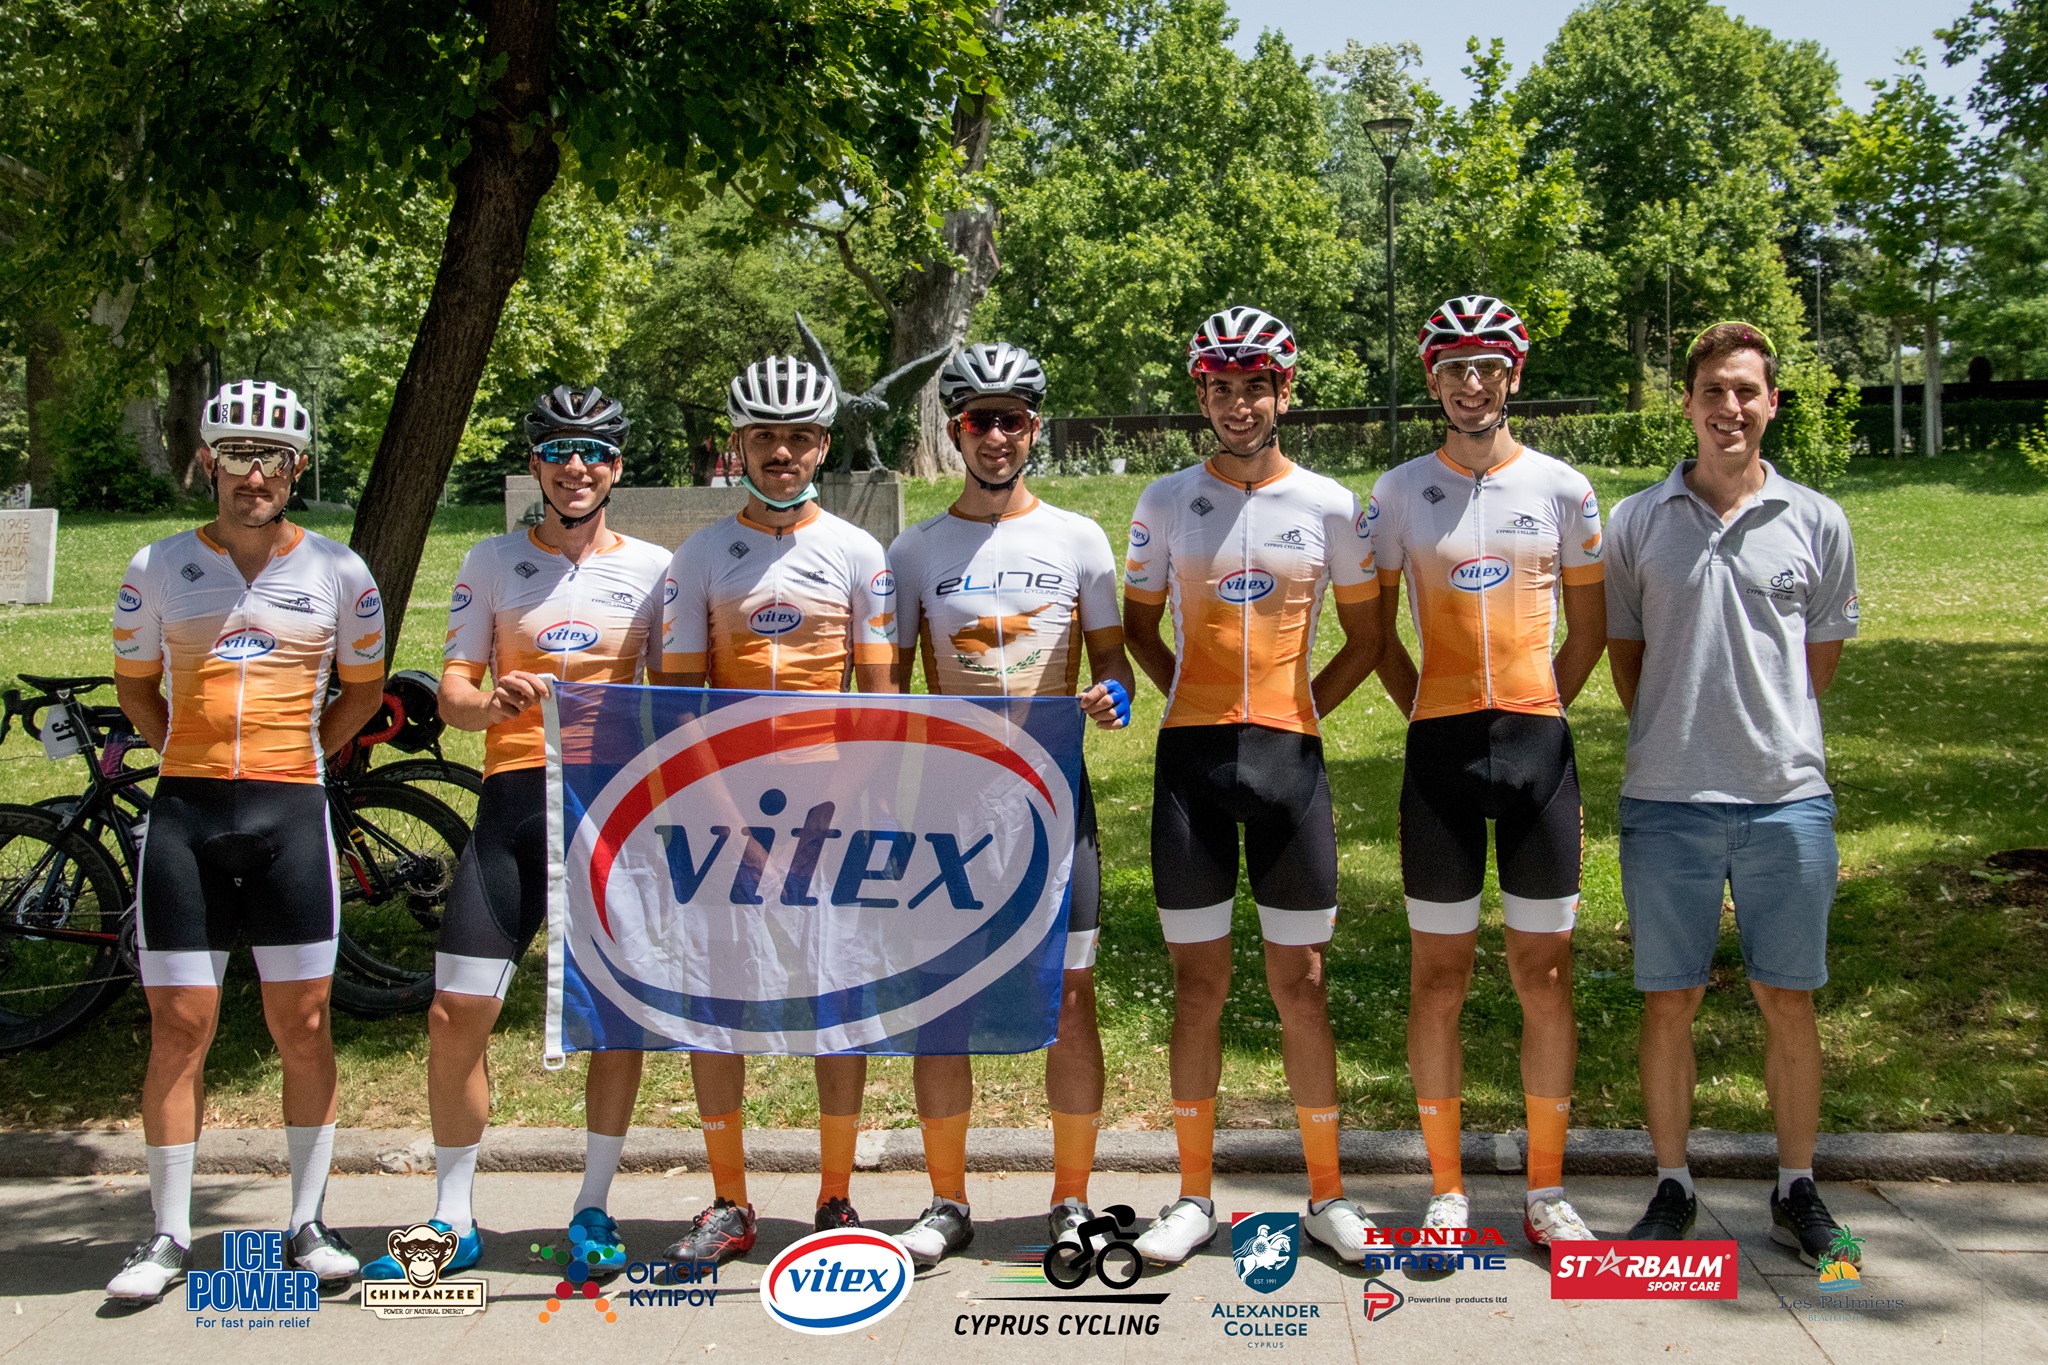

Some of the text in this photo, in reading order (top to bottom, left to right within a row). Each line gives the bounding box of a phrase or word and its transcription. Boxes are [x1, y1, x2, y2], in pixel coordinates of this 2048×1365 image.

[2, 518, 30, 530] 1945
[1458, 562, 1503, 580] vitex
[1226, 576, 1269, 592] vitex
[1024, 588, 1060, 596] CYCLING
[1746, 588, 1793, 601] CYPRUS CYCLING
[757, 610, 795, 624] vitex
[546, 627, 591, 643] vitex
[223, 636, 269, 649] vitex
[654, 788, 994, 911] vitex
